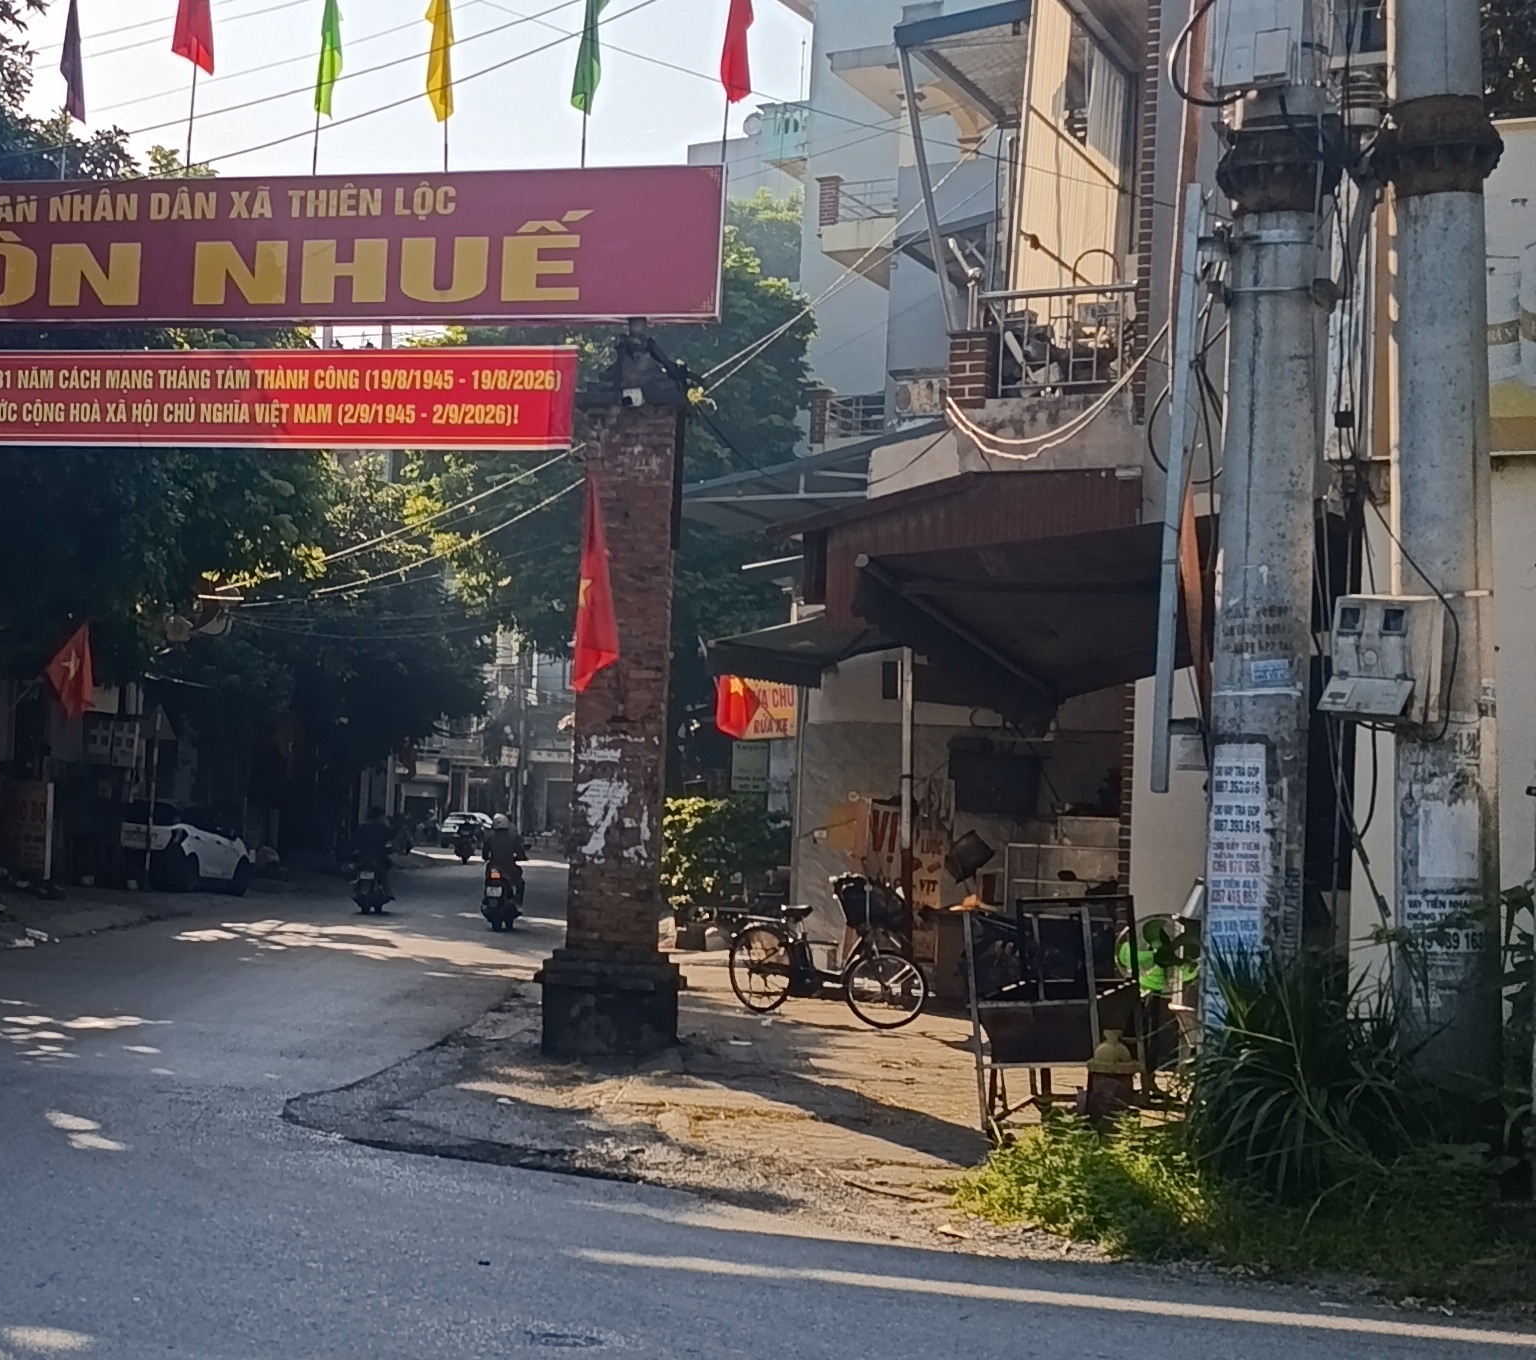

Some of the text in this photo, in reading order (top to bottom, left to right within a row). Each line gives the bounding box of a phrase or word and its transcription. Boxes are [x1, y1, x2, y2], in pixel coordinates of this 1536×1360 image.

[49, 187, 138, 222] NHÂN
[149, 186, 217, 221] DÂN
[228, 185, 273, 220] XÃ
[288, 181, 383, 217] THIÊN
[394, 178, 457, 221] LỘC
[192, 209, 594, 305] NHUẾ
[17, 365, 54, 389] NĂM
[58, 365, 101, 389] CÁCH
[105, 369, 154, 394] MẠNG
[158, 365, 211, 390] THÁNG
[215, 365, 250, 390] TÁM
[255, 365, 309, 390] THÀNH
[313, 364, 360, 390] CÔNG
[365, 368, 454, 392] (19/8/1945
[471, 368, 562, 392] 19/8/2026)
[22, 398, 65, 426] CỘNG
[69, 398, 101, 423] HOÀ
[105, 398, 127, 423] XÃ
[131, 398, 159, 427] HỘI
[163, 396, 196, 423] CHỦ
[200, 399, 250, 423] NGHĨA
[254, 398, 290, 428] VIỆT
[293, 403, 332, 424] NAM
[338, 403, 416, 426] (2/9/1945
[432, 403, 520, 427] 2/9/2026)!
[1425, 896, 1446, 909] TIỀN
